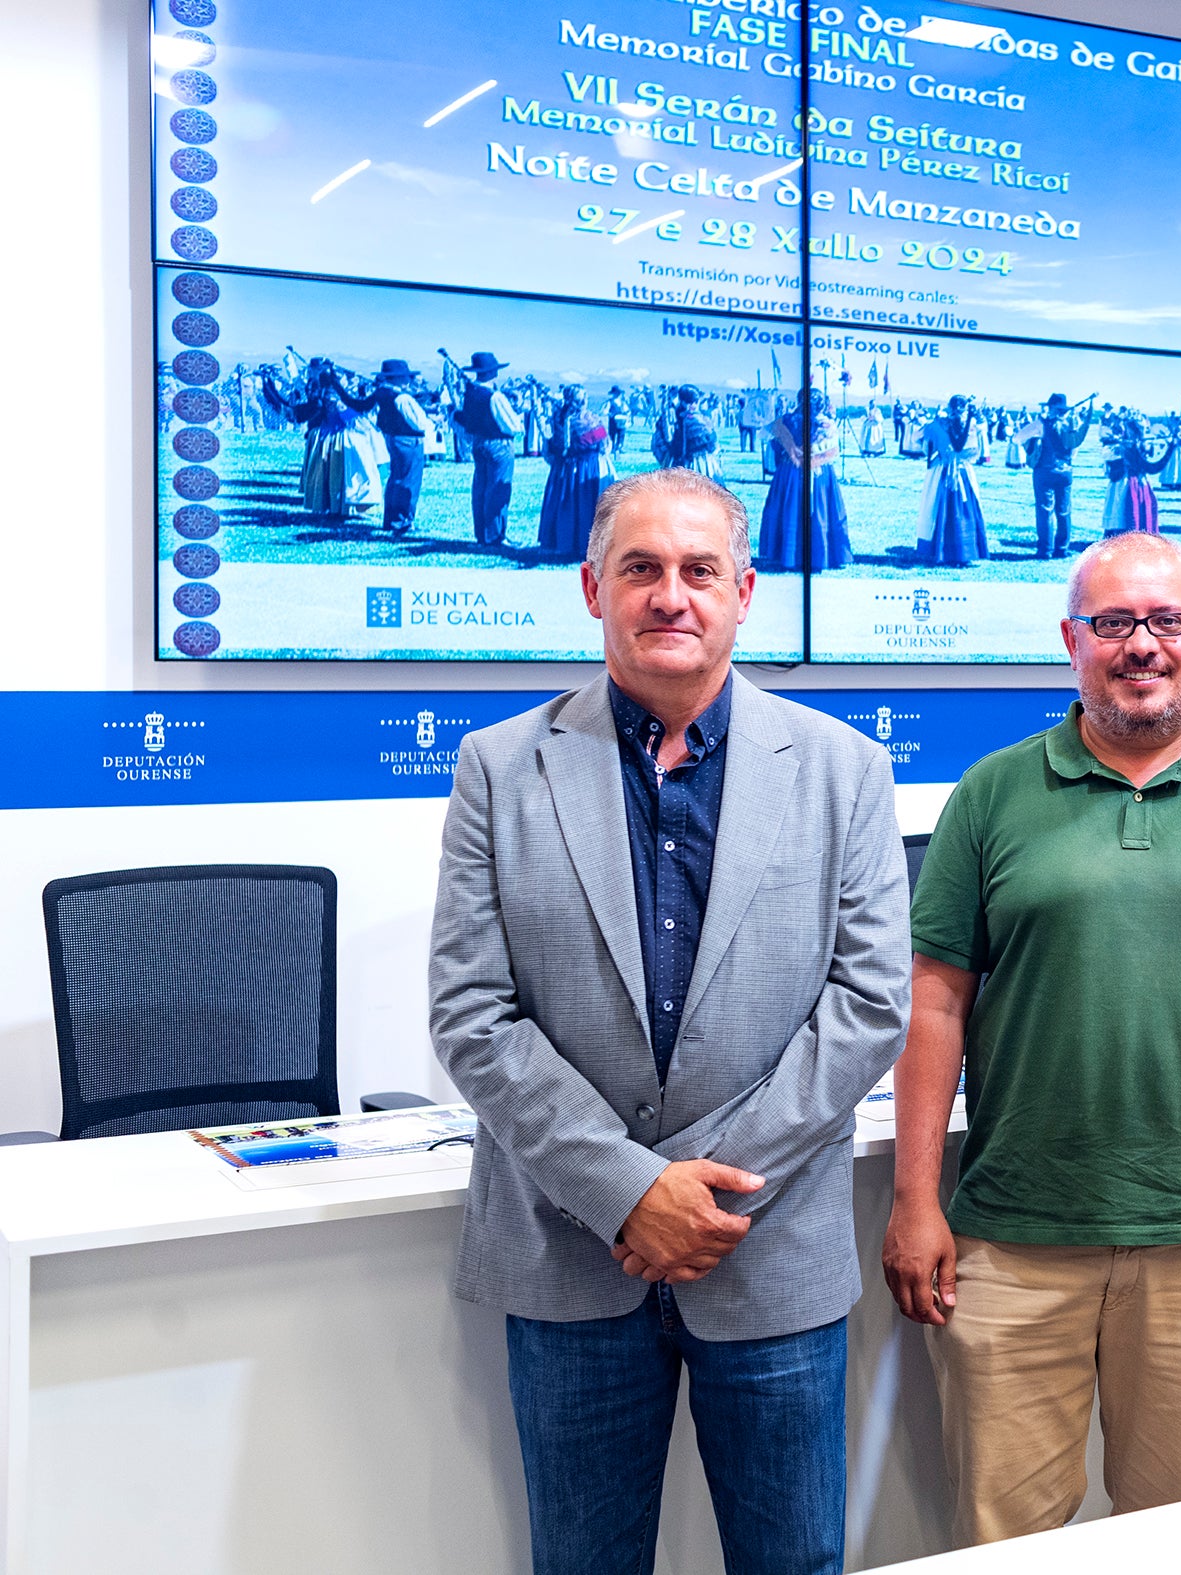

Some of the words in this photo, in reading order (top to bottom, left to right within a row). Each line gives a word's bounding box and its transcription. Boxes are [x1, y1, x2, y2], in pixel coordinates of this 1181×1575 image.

[689, 8, 786, 49] FASE
[810, 28, 915, 69] FINAL
[858, 6, 908, 37] de
[921, 15, 1059, 61] das
[1070, 41, 1115, 71] de
[558, 19, 750, 71] Memorial
[761, 52, 897, 92] Gabino
[908, 75, 1026, 112] García
[562, 71, 619, 105] VII
[635, 81, 777, 128] Serán
[794, 106, 853, 138] da
[867, 114, 1023, 161] Seitura
[502, 95, 697, 146] Memorial
[711, 125, 868, 168] Ludivina
[879, 147, 981, 183] Pérez
[992, 162, 1070, 194] Ricoi
[487, 142, 618, 186] Noite
[633, 161, 760, 203] Celta
[774, 178, 835, 211] de
[848, 187, 1081, 240] Manzaneda
[574, 204, 640, 236] 27
[656, 219, 682, 242] e
[698, 217, 757, 250] 28
[770, 225, 884, 262] Xullo
[898, 240, 1013, 276] 2024
[638, 260, 739, 284] Transmisión
[744, 274, 771, 287] por
[774, 274, 904, 303] Videostreaming
[908, 289, 959, 306] canles:
[897, 340, 940, 359] LIVE
[411, 591, 488, 607] XUNTA
[410, 610, 438, 625] DE
[447, 610, 536, 626] GALICIA
[874, 622, 969, 635] DEPUTACIÓN
[886, 637, 957, 648] OURENSE
[102, 752, 205, 768] DEPUTACIÓN
[380, 748, 460, 763] DEPUTACIÓ
[116, 768, 192, 781] OURENSE
